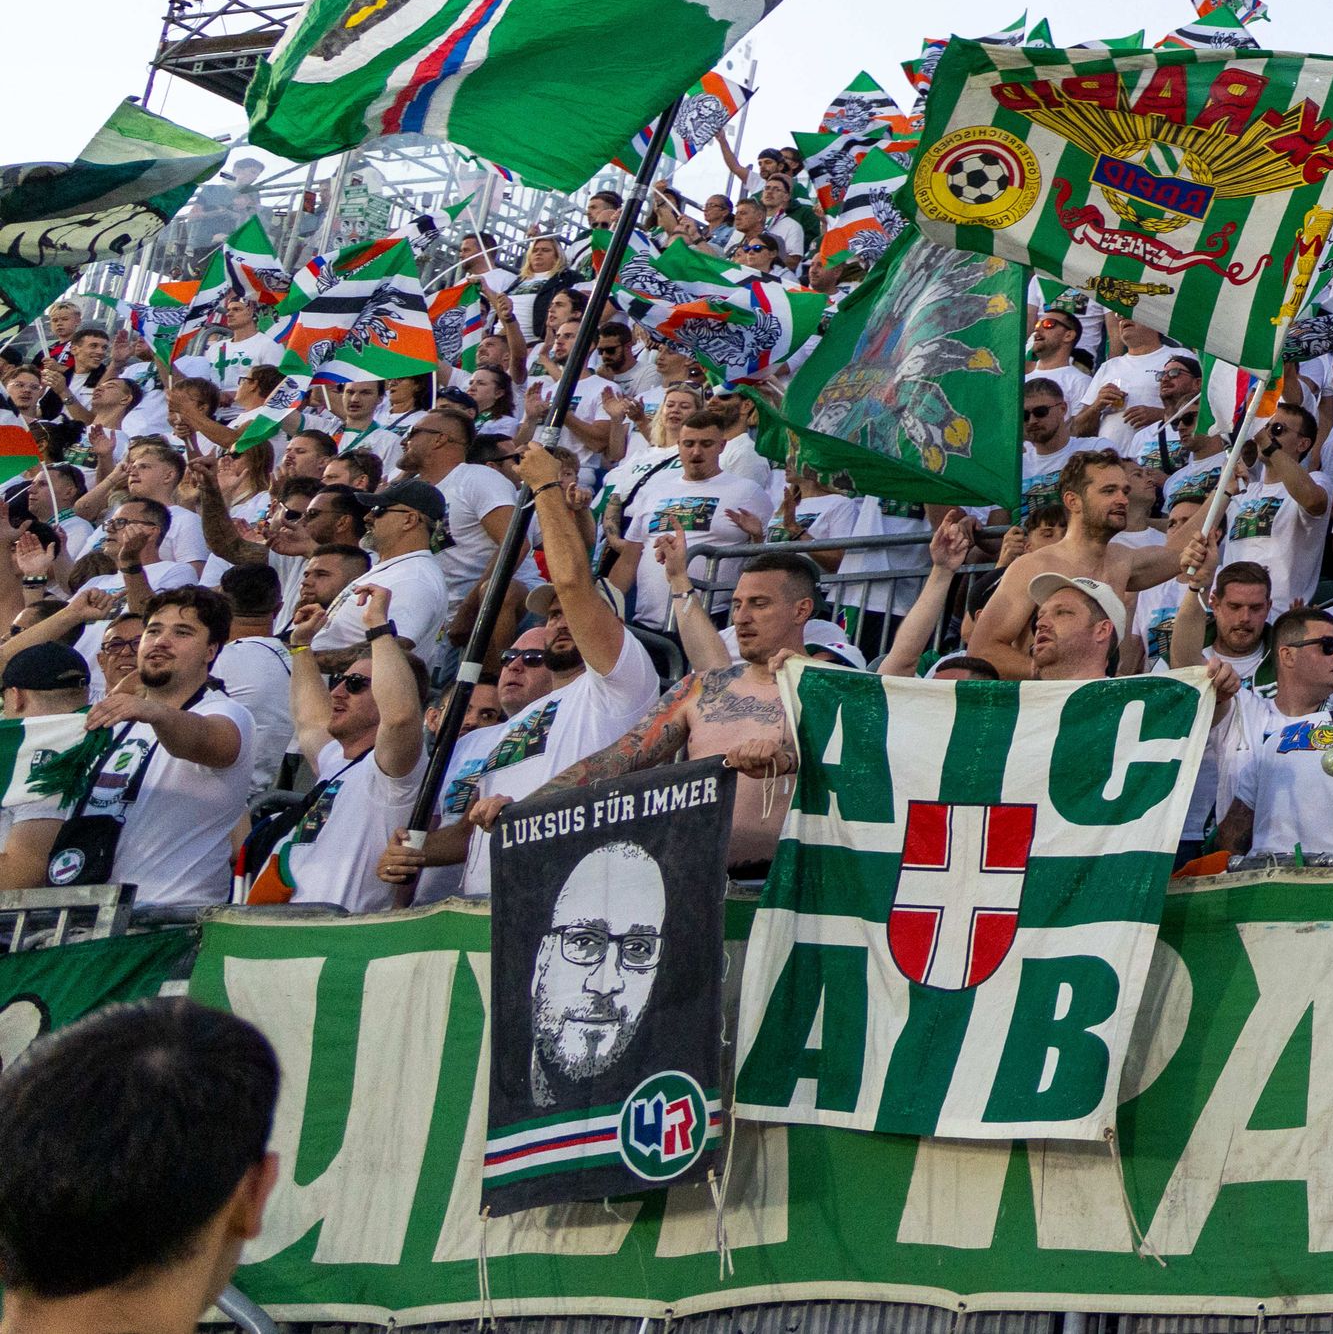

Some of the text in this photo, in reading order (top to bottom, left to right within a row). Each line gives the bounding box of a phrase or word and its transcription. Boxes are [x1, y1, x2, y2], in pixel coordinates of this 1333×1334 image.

[501, 776, 718, 849] LUKSUS FÜR IMMER
[629, 1091, 697, 1163] UR
